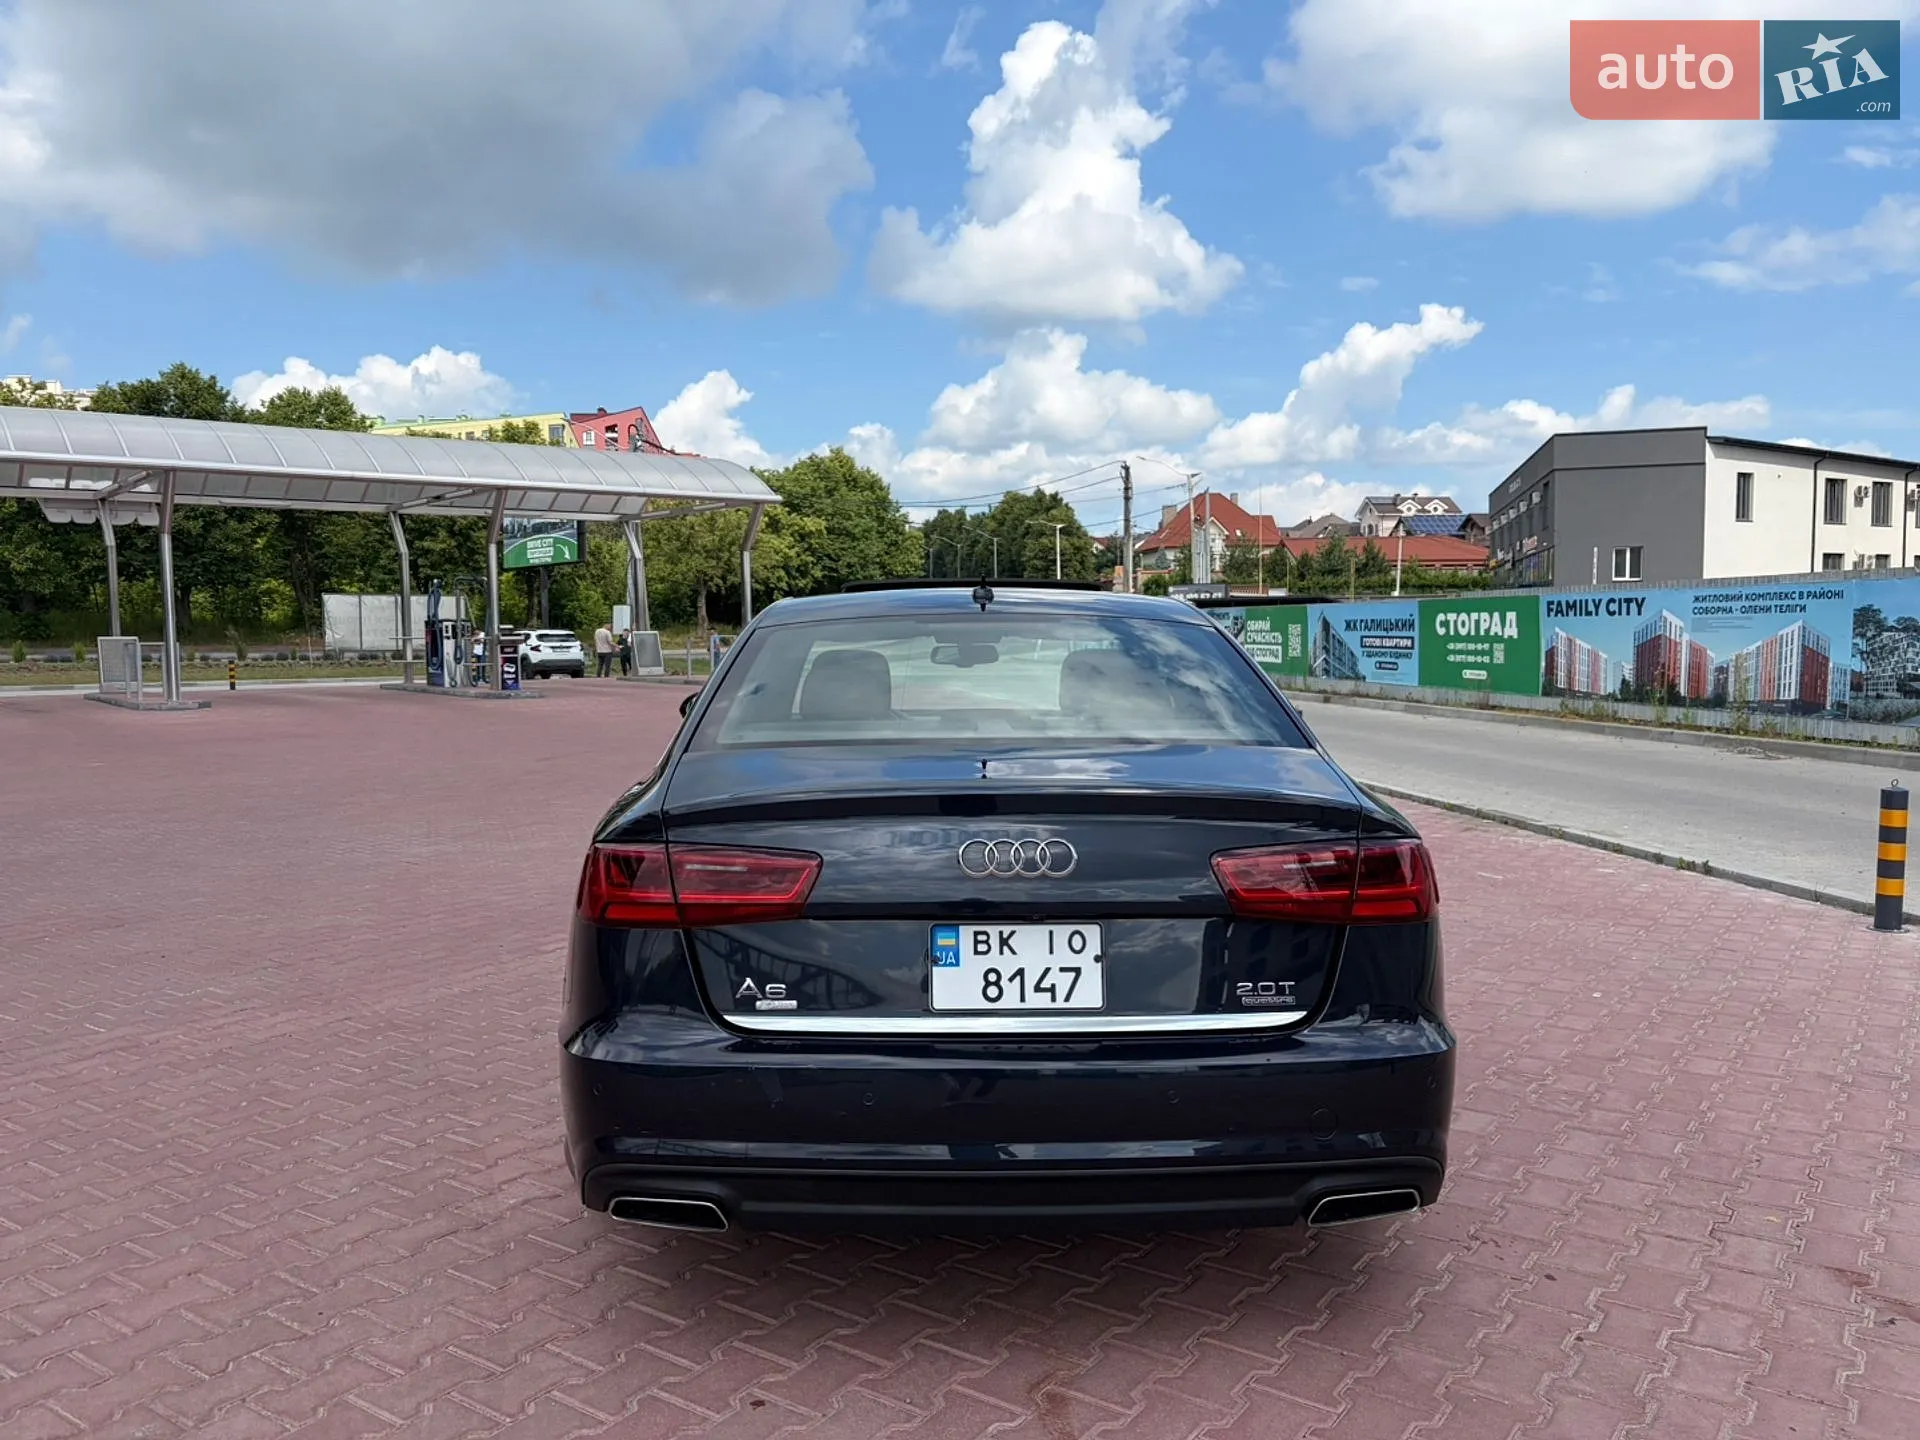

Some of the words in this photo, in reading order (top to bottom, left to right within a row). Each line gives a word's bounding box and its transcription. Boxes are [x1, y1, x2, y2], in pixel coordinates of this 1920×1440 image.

[1692, 590, 1744, 604] ЖИТЛОВИЙ
[1744, 590, 1798, 602] КОМПЛЕКС
[1798, 590, 1805, 600] В
[1806, 587, 1844, 600] РАЙОНІ
[1546, 598, 1603, 618] FAMILY
[1605, 597, 1647, 617] CITY
[1692, 606, 1735, 616] СОБОРНА
[1740, 604, 1773, 615] ОЛЕНИ
[1774, 603, 1807, 614] ТЕЛІГИ
[1246, 616, 1271, 631] ОБИРАЙ
[1344, 619, 1359, 632] ЖК
[1360, 613, 1415, 634] ГАЛИЦЬКИЙ
[1435, 611, 1518, 639] СТОГРАД
[937, 952, 956, 965] UA
[973, 930, 1018, 956] BK
[735, 977, 787, 999] A6
[981, 967, 1082, 1004] 8147
[1236, 981, 1296, 996] 2.0T
